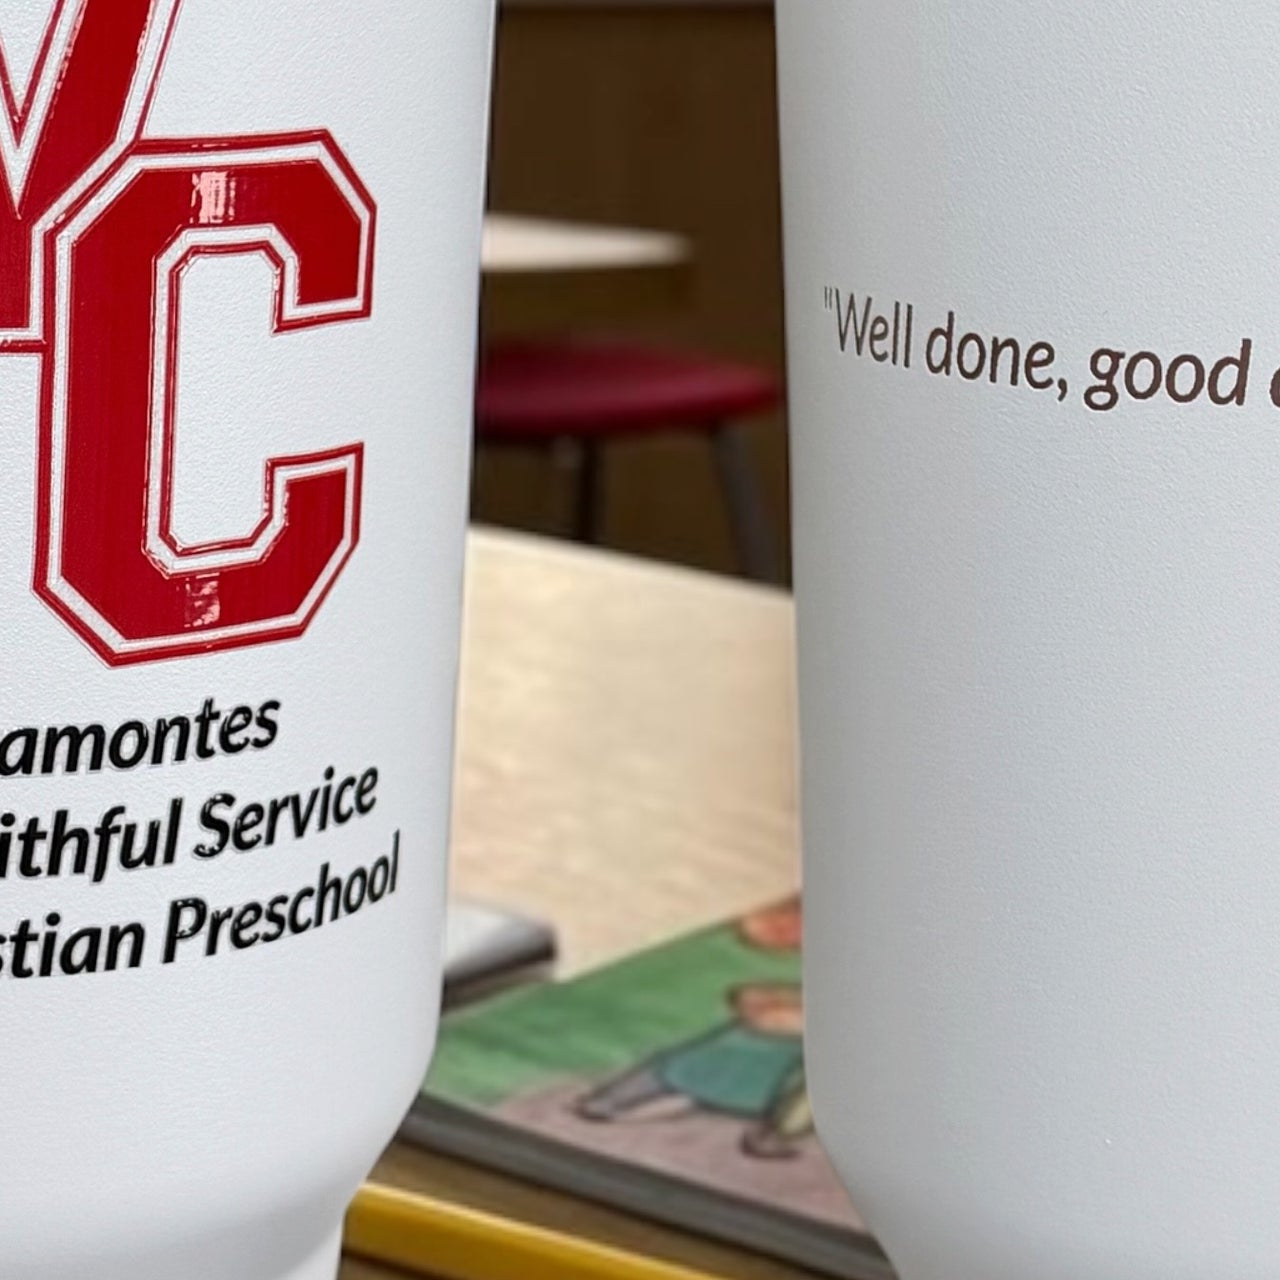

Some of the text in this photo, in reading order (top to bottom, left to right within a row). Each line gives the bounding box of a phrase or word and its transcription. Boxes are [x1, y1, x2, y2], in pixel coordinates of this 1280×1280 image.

[823, 286, 915, 369] "Well
[924, 309, 1069, 403] done,
[1082, 337, 1253, 412] good
[192, 765, 379, 859] Service
[161, 829, 400, 965] Preschool
